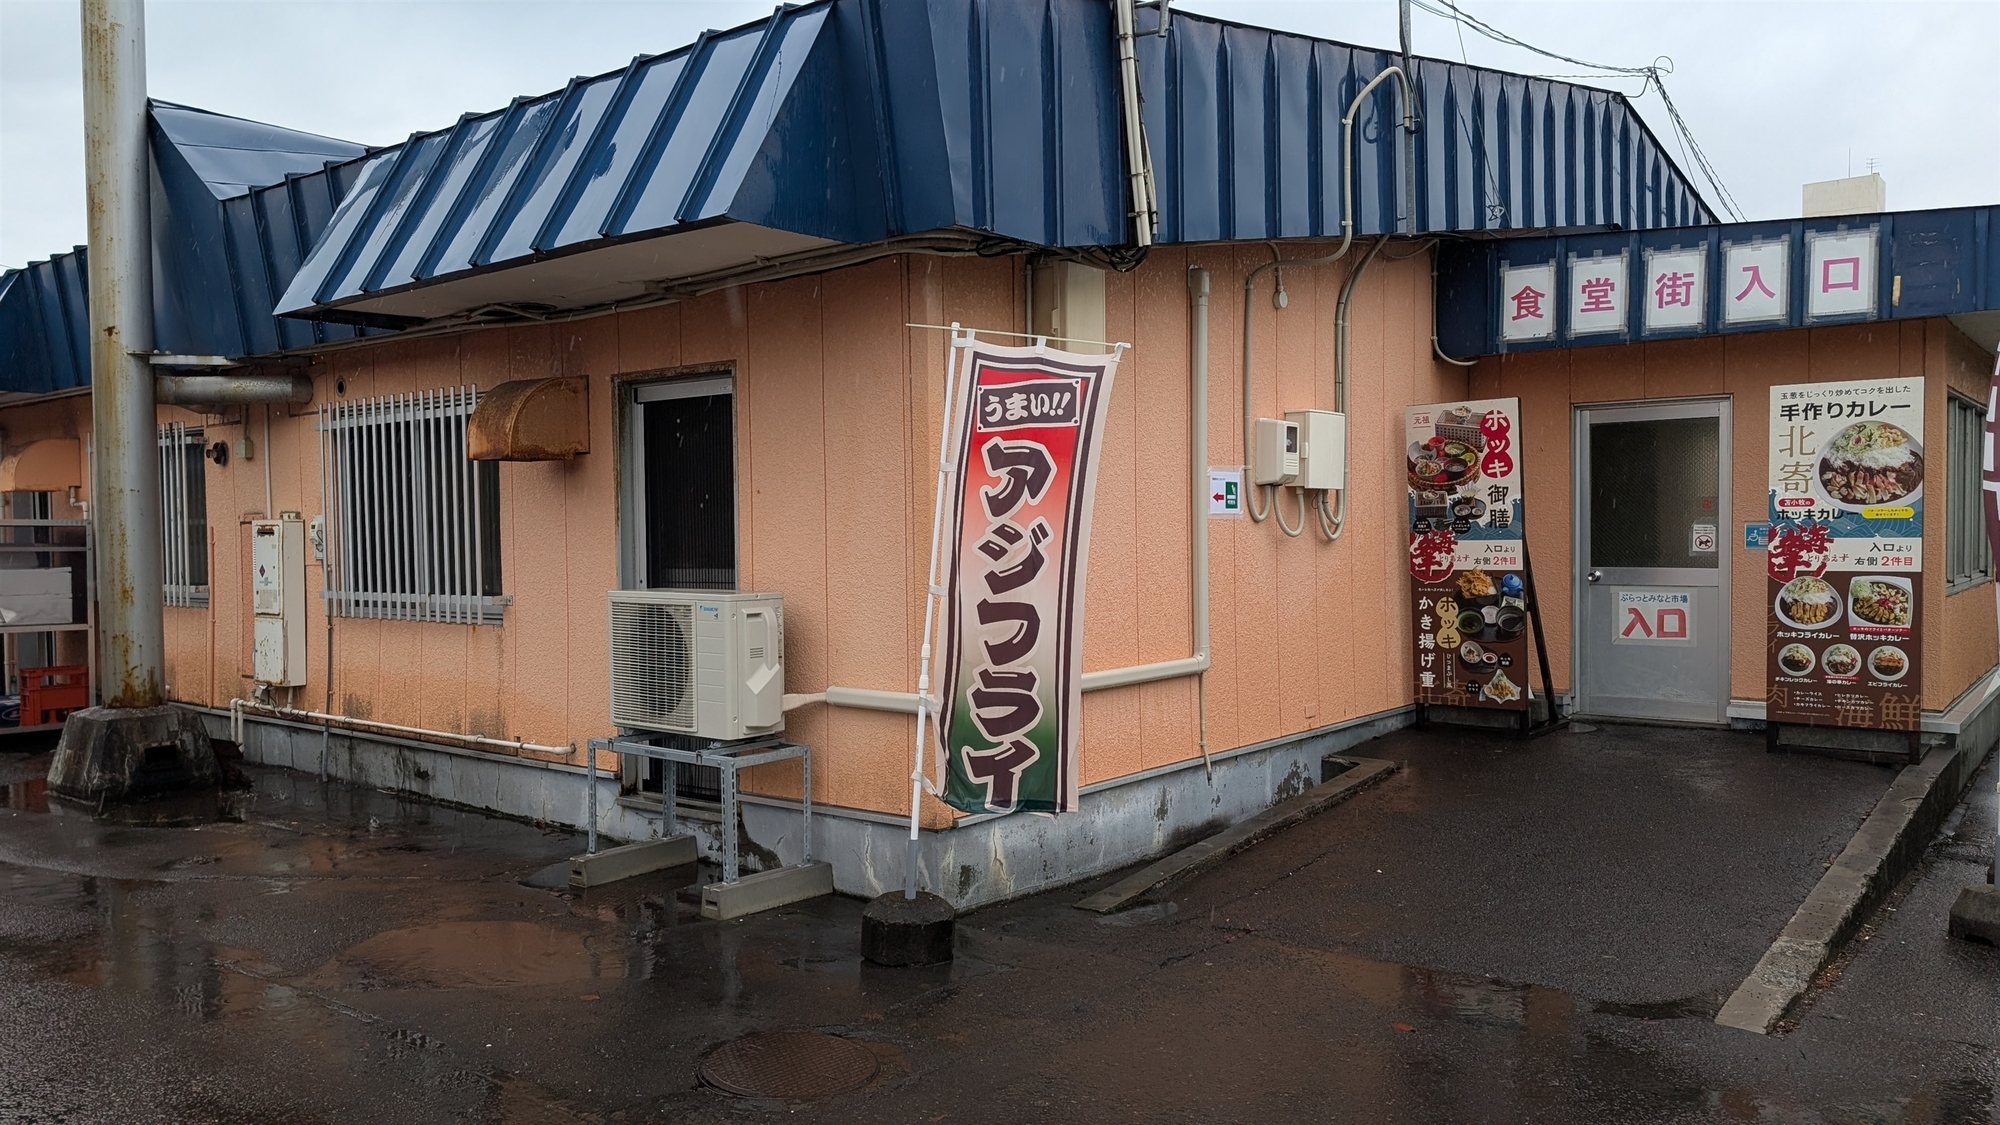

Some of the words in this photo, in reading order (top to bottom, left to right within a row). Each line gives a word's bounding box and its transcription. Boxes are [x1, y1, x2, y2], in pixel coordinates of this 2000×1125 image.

[1510, 256, 1861, 322] 食堂街入口
[984, 392, 1070, 422] うまい!!
[1413, 415, 1431, 425] 元祖
[1780, 400, 1911, 422] 手作りカレー
[1778, 425, 1816, 494] 北寄
[1776, 508, 1859, 520] ホッキカレー
[1484, 543, 1516, 554] 入口より
[1869, 542, 1913, 553] 入口より
[966, 441, 1053, 809] アジフライ
[1440, 597, 1457, 649] ホッキ
[1621, 607, 1687, 638] 入口
[1776, 631, 1840, 639] ホッキフライカレー
[1418, 596, 1436, 688] かき揚げ重
[1849, 633, 1910, 642] 贅沢ホッキカレー
